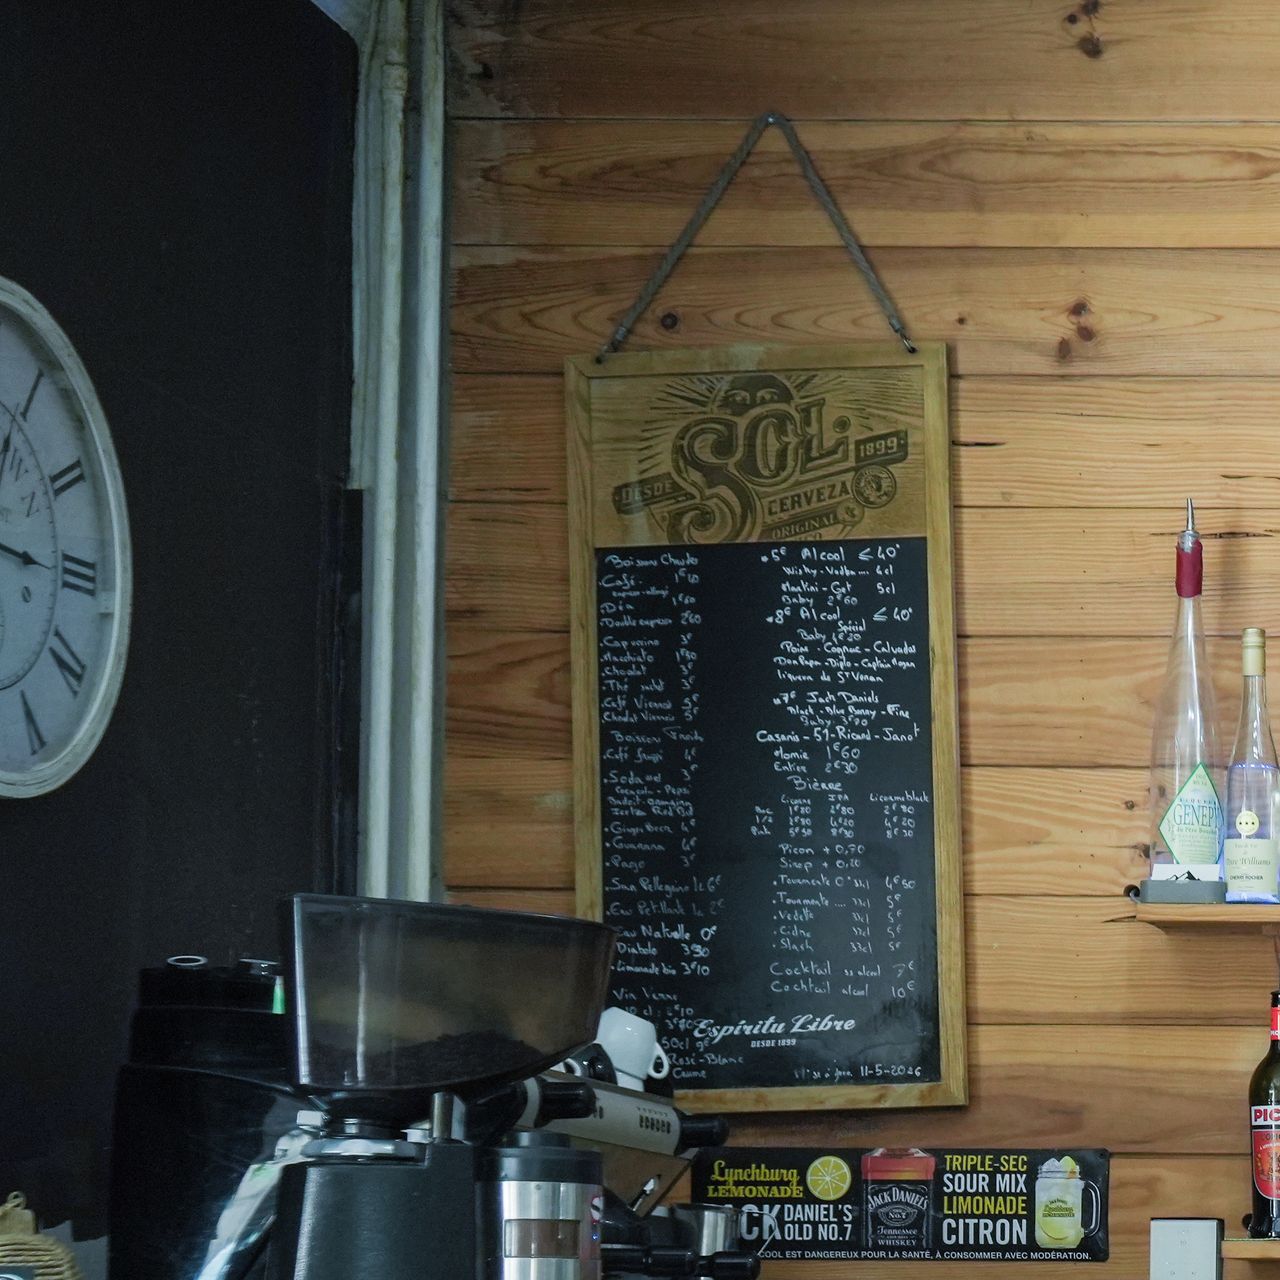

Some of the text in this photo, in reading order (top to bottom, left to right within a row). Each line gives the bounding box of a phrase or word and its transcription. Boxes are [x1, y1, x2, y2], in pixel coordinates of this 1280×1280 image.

[859, 437, 898, 458] 1899
[621, 480, 673, 499] DESDE
[767, 480, 850, 517] CERVEZA
[771, 513, 838, 540] ORIGINAL
[771, 547, 845, 562] 5€ Alcool
[830, 580, 852, 593] Get
[774, 606, 841, 625] 8€ Alcool
[823, 642, 862, 660] Cognac
[837, 690, 879, 704] Daniels
[756, 723, 920, 743] Casanis 51 Ricard Janot
[774, 742, 860, 760] Momie 1€60
[608, 770, 644, 784] Soda
[778, 843, 815, 855] Picon
[886, 894, 901, 909] 5€
[888, 909, 902, 923] 5€
[887, 924, 902, 939] 5€
[769, 960, 914, 978] Cocktail 7€
[770, 977, 915, 999] Cocktail 10€
[693, 1014, 786, 1044] Espíritu
[789, 1013, 856, 1034] Libre
[751, 1038, 797, 1048] DESDE 1899
[945, 1155, 1028, 1172] TRIPLE-SEC
[710, 1160, 800, 1189] Lynchburg
[943, 1173, 1027, 1193] SOUR MIX
[707, 1186, 803, 1198] LEMONADE
[867, 1187, 930, 1211] JACK DANIEL'S
[784, 1204, 853, 1222] DANIEL'S
[943, 1196, 1027, 1215] LIMONADE
[784, 1224, 852, 1241] OLD NO.7
[877, 1226, 918, 1236] Tennessee
[942, 1218, 1027, 1246] CITRON
[877, 1239, 917, 1247] WHISKEY
[785, 1248, 1092, 1260] EST DANGEREUX POUR LA SANTÉ, À CONSOMMER AVEC MODÉRATION.
